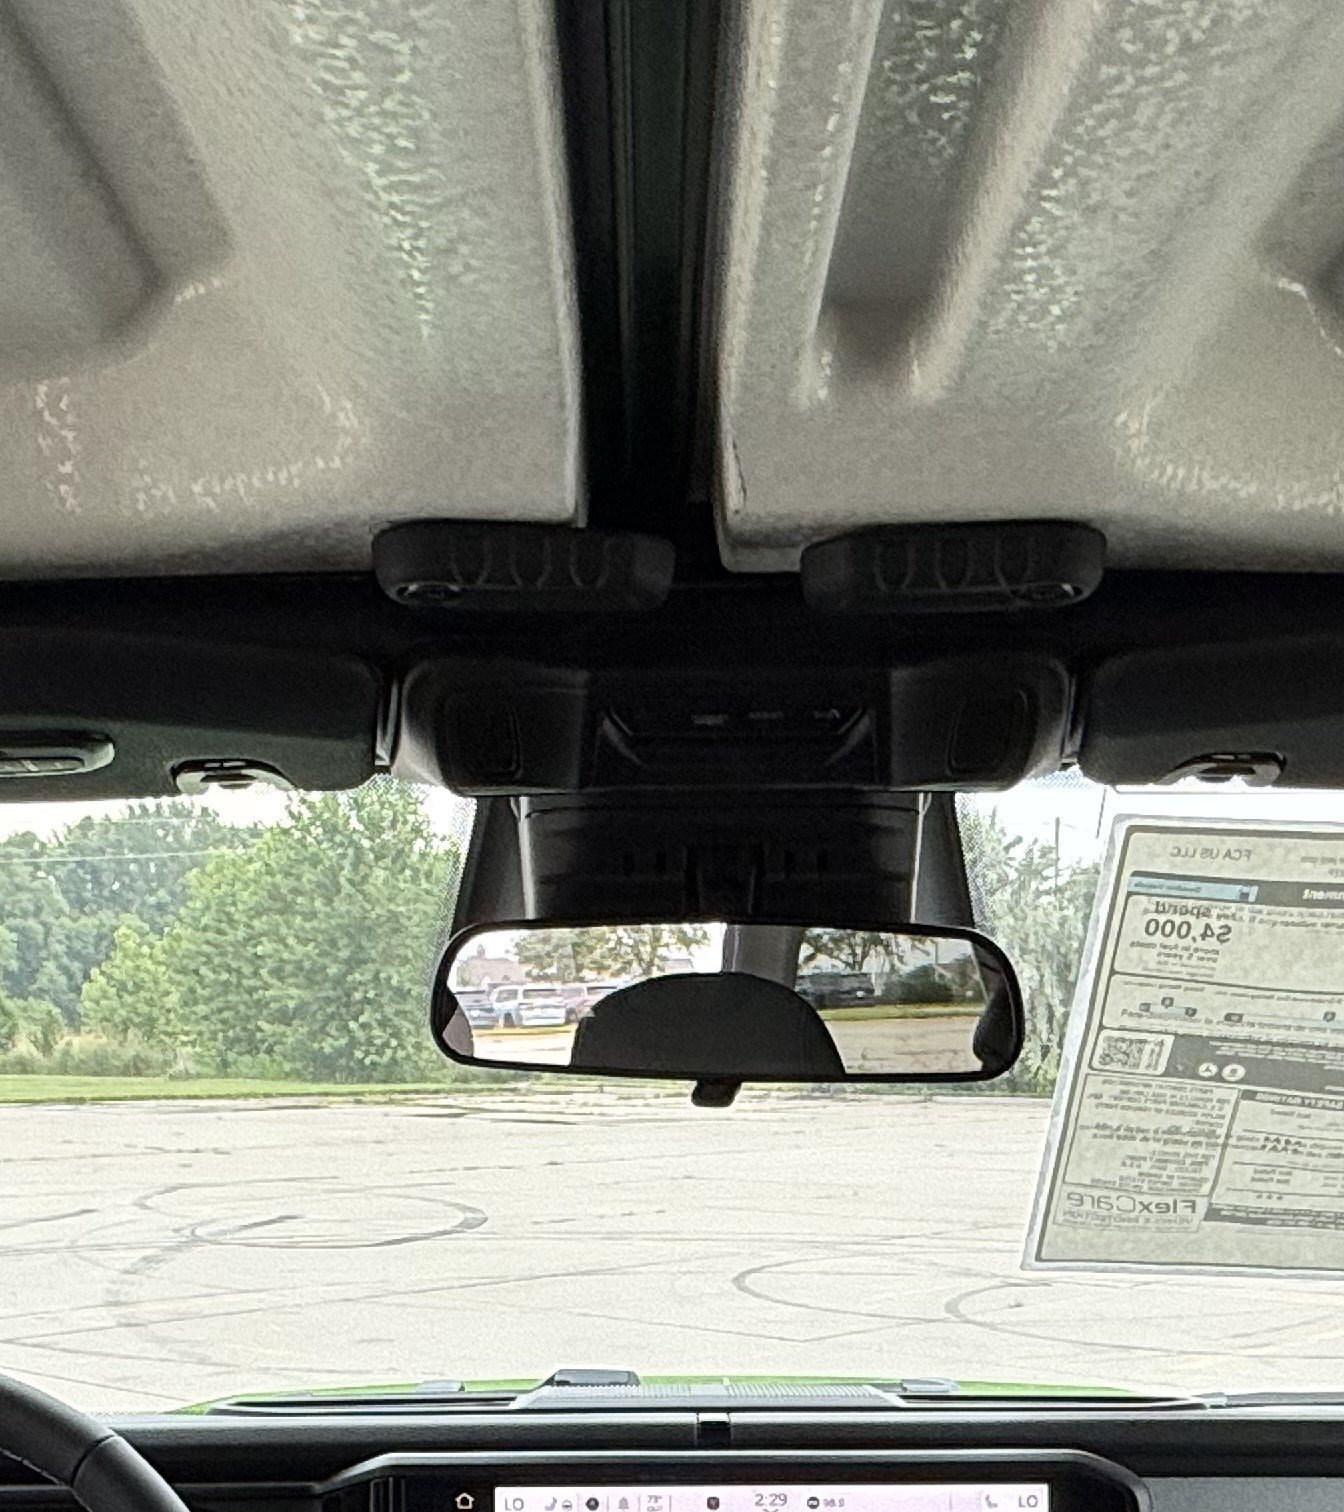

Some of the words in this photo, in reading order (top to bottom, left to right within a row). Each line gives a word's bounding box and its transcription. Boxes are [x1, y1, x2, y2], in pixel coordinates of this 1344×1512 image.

[504, 1497, 524, 1511] LO
[754, 1493, 788, 1507] 2:29
[1018, 1495, 1038, 1508] LO
